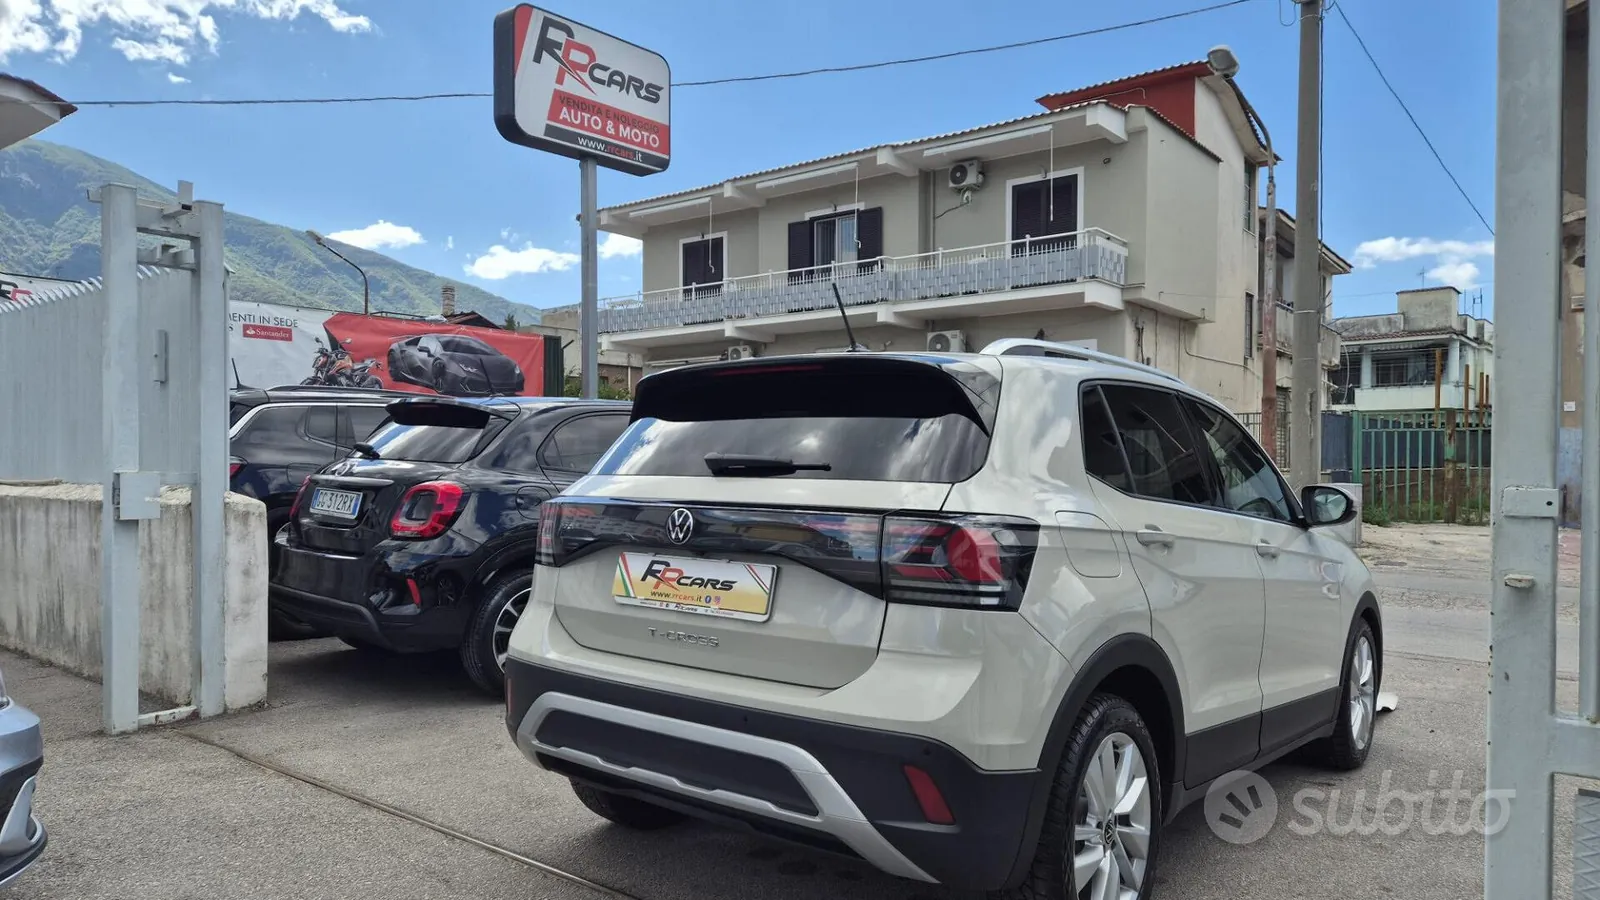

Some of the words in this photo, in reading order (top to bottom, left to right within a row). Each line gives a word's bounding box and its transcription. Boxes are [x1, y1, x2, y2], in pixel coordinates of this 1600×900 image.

[559, 95, 602, 117] VENDITA
[605, 109, 612, 119] E
[613, 113, 659, 134] NOLEGGIO
[560, 106, 602, 130] AUTO
[606, 120, 615, 135] &
[619, 124, 660, 148] MOTO
[577, 136, 643, 163] www.rrcars.it
[259, 315, 271, 325] IN
[273, 317, 298, 328] SEDE
[256, 329, 289, 338] Santander
[650, 590, 702, 603] www.rrcars.it
[648, 626, 719, 647] T-CROSS
